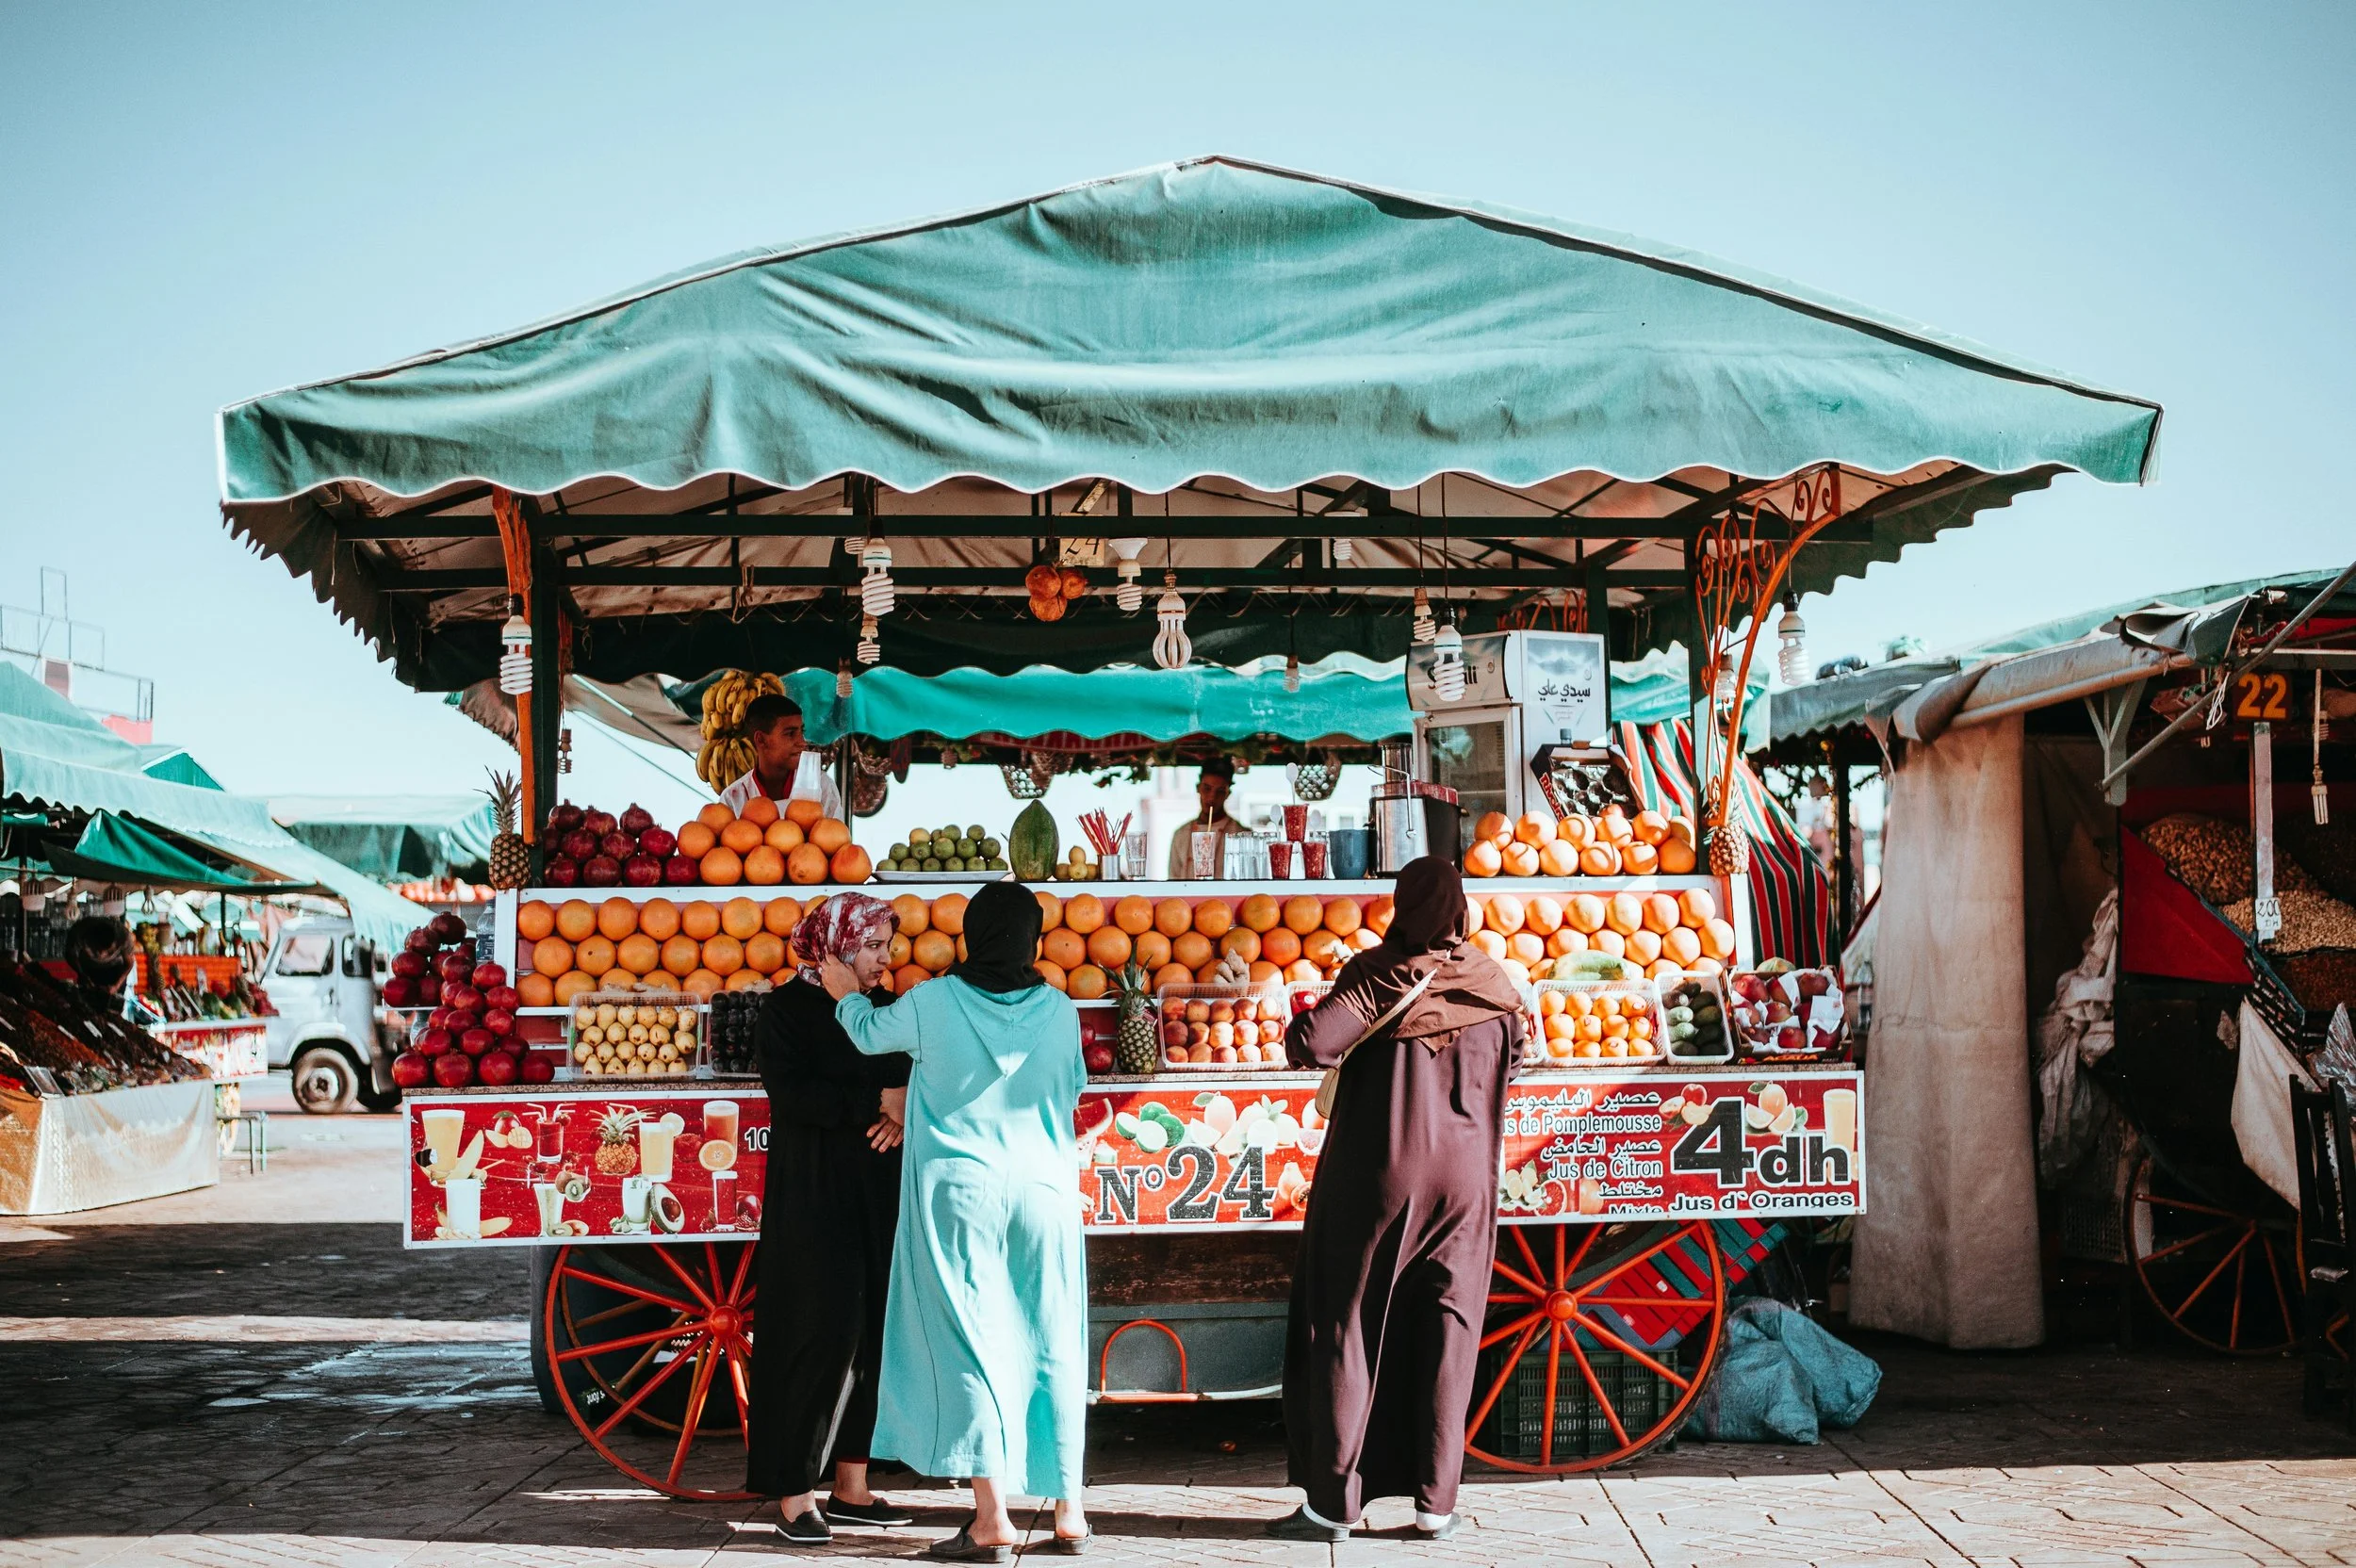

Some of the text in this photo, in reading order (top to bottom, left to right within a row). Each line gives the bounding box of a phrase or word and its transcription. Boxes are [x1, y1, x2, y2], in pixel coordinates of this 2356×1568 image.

[1537, 678, 1591, 703] سيدي علي
[2237, 672, 2287, 719] 22
[1601, 1092, 1661, 1111] عصير
[1520, 1116, 1539, 1134] de
[1544, 1113, 1661, 1136] Pomplemousse
[1542, 1138, 1661, 1160] عصير الحامض
[1549, 1158, 1662, 1179] Jus de Citron
[1598, 1182, 1661, 1198] مختلط
[1671, 1196, 1712, 1212] Jus
